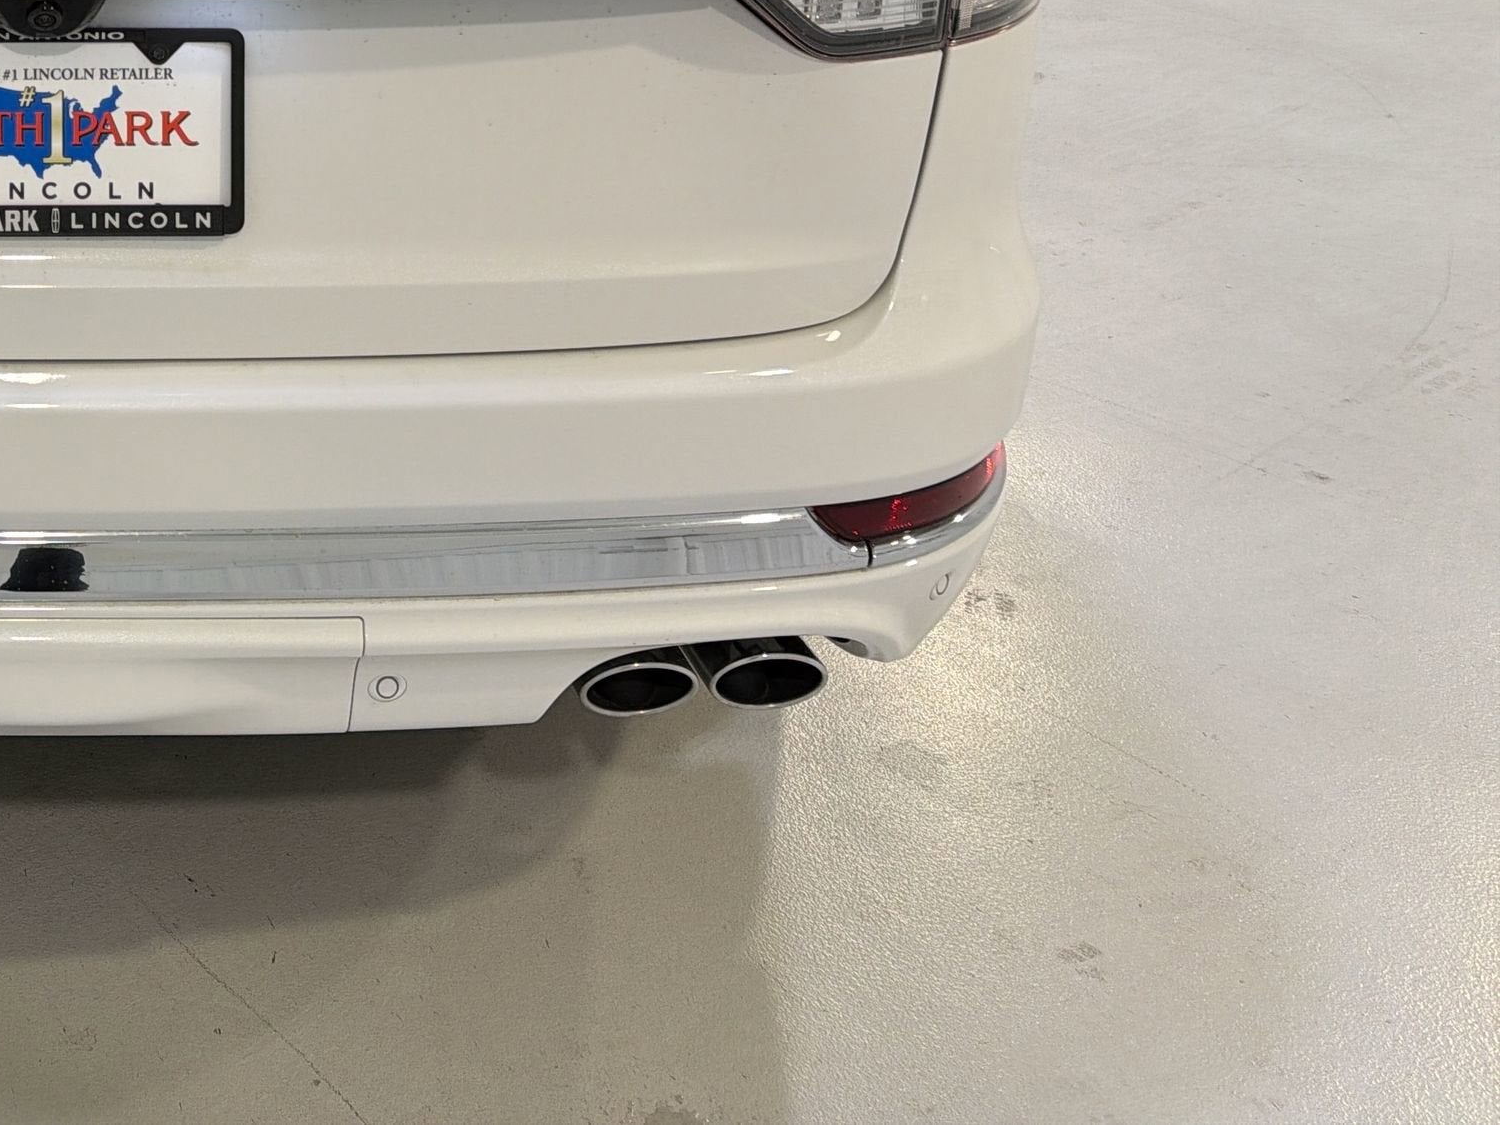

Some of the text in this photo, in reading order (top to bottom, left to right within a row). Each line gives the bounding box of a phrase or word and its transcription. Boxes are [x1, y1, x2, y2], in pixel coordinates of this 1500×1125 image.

[18, 31, 125, 41] ONIO
[2, 68, 18, 81] #1
[23, 67, 95, 81] LINCOLN
[99, 66, 174, 81] RETAILER
[71, 110, 200, 147] PARK
[70, 211, 213, 230] LINCOLN
